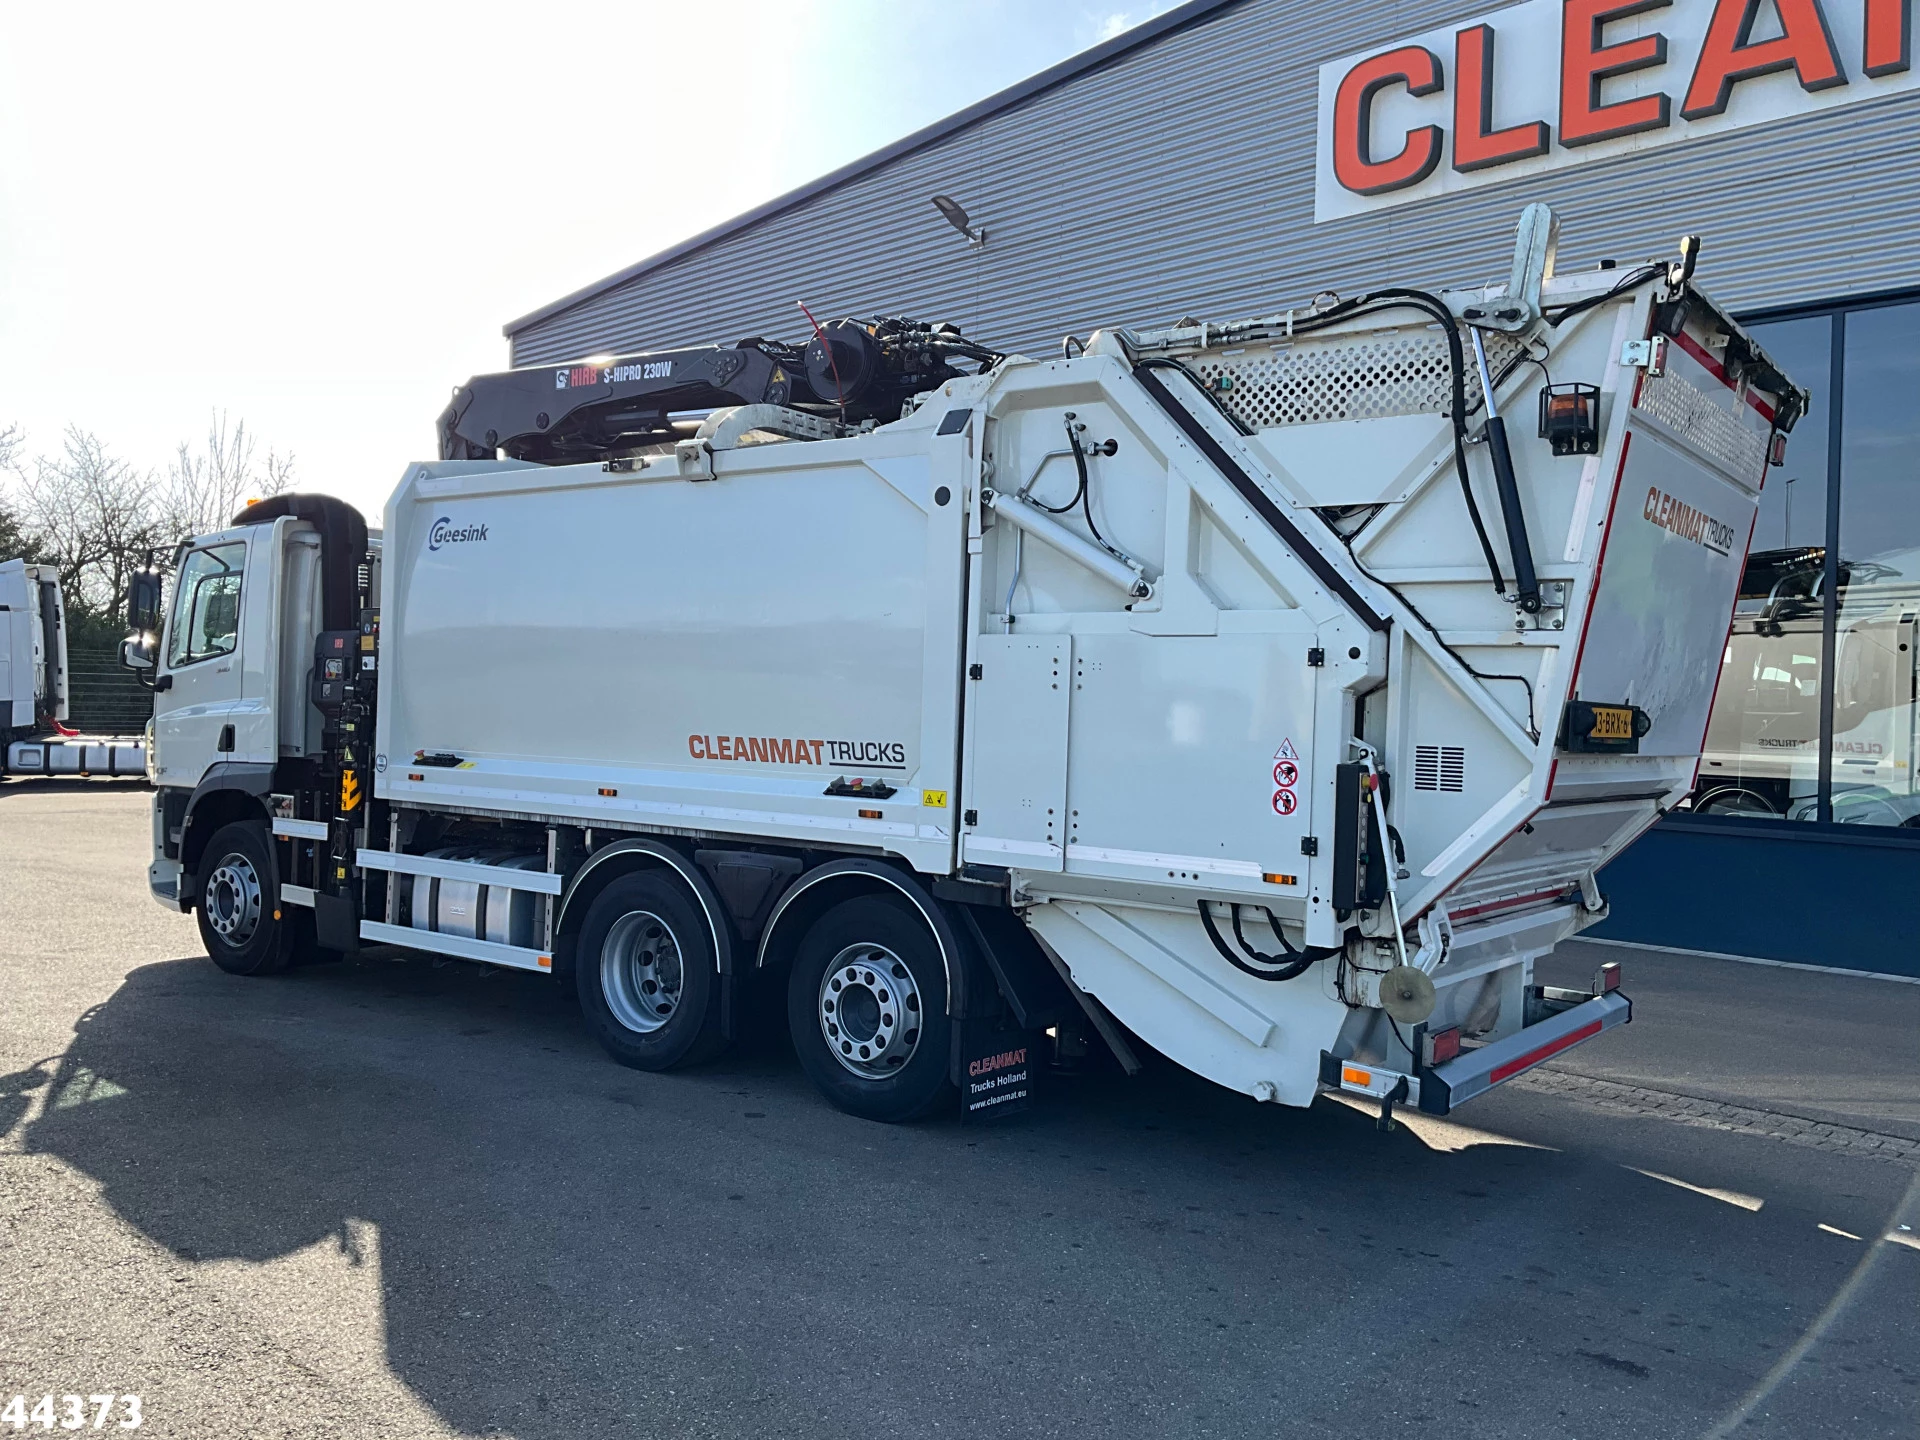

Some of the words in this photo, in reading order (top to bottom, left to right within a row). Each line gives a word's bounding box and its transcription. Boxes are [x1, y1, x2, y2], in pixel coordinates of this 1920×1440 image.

[571, 367, 597, 387] HIAB
[603, 364, 641, 384] S-HIPRO
[643, 360, 672, 379] 230W
[1643, 486, 1709, 545] CLEANMAT
[1706, 517, 1735, 550] TRUCKS
[430, 519, 490, 546] Geesink
[688, 734, 825, 766] CLEANMAT
[826, 740, 905, 763] TRUCKS
[969, 1048, 1027, 1077] CLEANMAT
[970, 1079, 996, 1094] Trucks
[997, 1070, 1027, 1087] Holland
[969, 1090, 1027, 1111] www.cleanmat.eu
